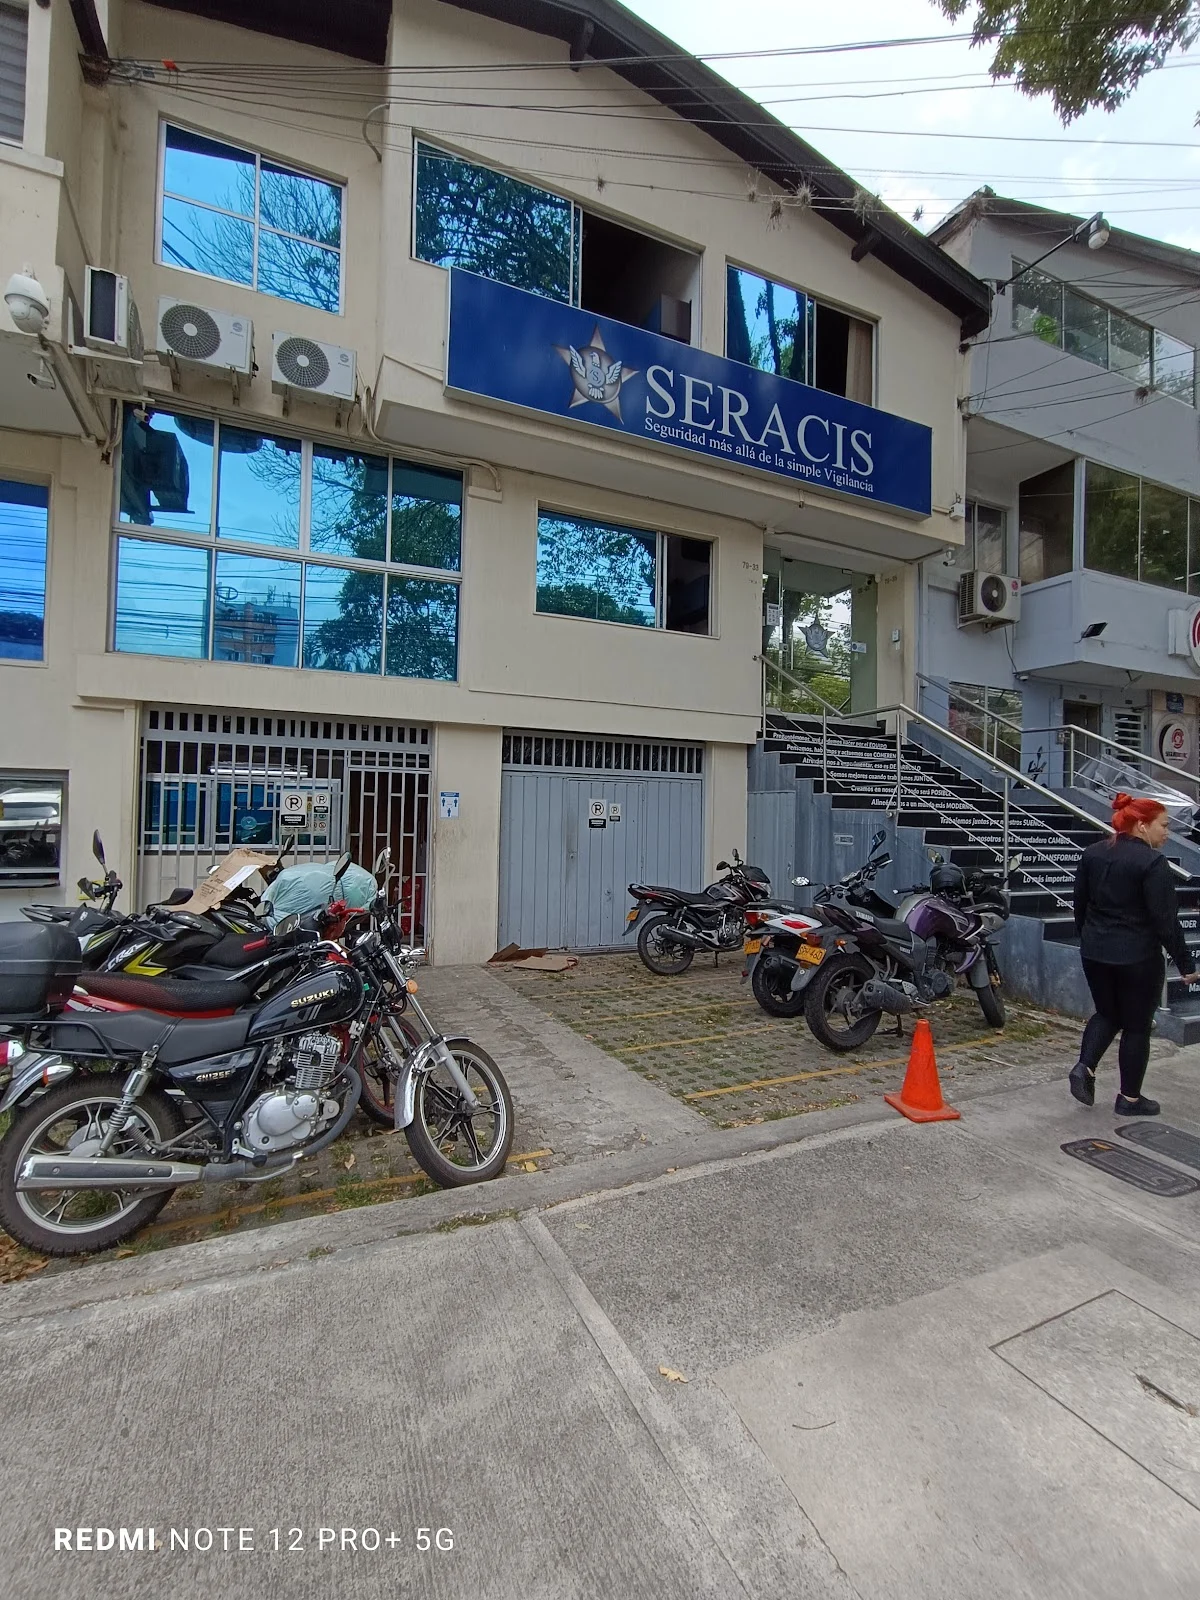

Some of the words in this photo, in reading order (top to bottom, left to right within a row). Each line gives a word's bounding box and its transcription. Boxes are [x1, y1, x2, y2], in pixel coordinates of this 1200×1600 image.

[646, 365, 874, 476] SERACIS
[644, 418, 706, 446] Seguridad
[709, 437, 732, 453] más
[735, 442, 756, 460] allá
[759, 449, 772, 464] de
[775, 453, 784, 468] la
[787, 458, 821, 478] simple
[824, 468, 874, 492] Vigilancia
[848, 772, 867, 780] mejores
[936, 801, 945, 809] más
[972, 817, 989, 826] juntos
[1032, 855, 1037, 863] y
[1023, 875, 1031, 883] Lo
[291, 988, 335, 1008] SUZUKI
